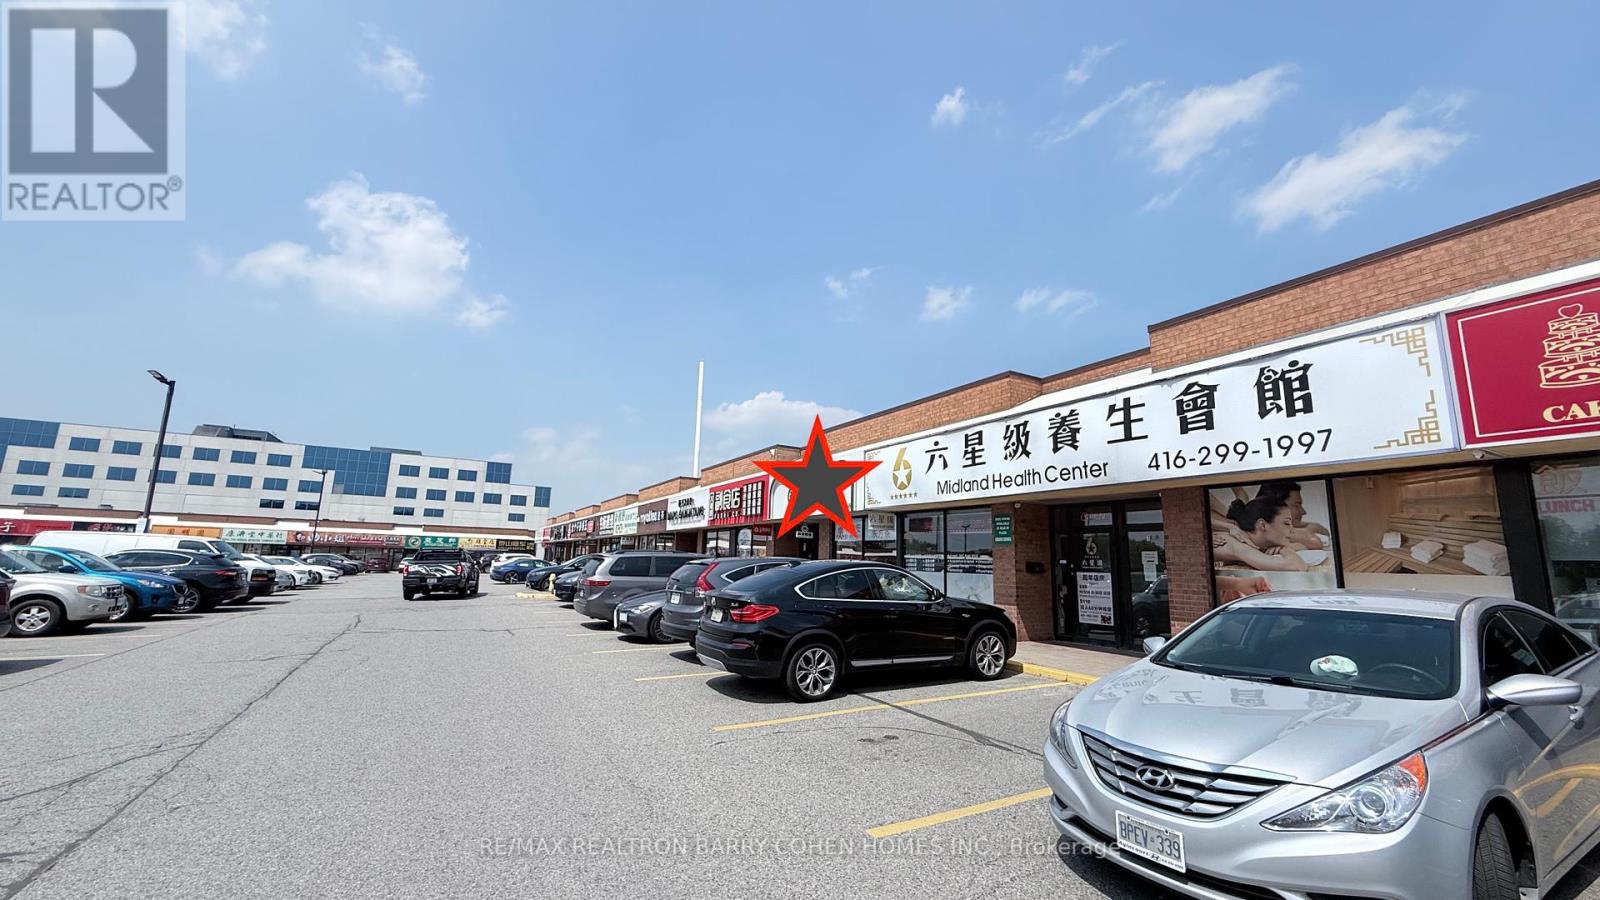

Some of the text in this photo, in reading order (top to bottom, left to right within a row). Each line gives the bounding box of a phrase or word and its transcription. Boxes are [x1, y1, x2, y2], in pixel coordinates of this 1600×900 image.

[925, 360, 1313, 474] 六星級養生會館
[1147, 428, 1333, 471] 416-299-1997
[936, 461, 1109, 495] Midland Health Center
[1119, 820, 1148, 849] BPEV
[1156, 834, 1181, 859] 339
